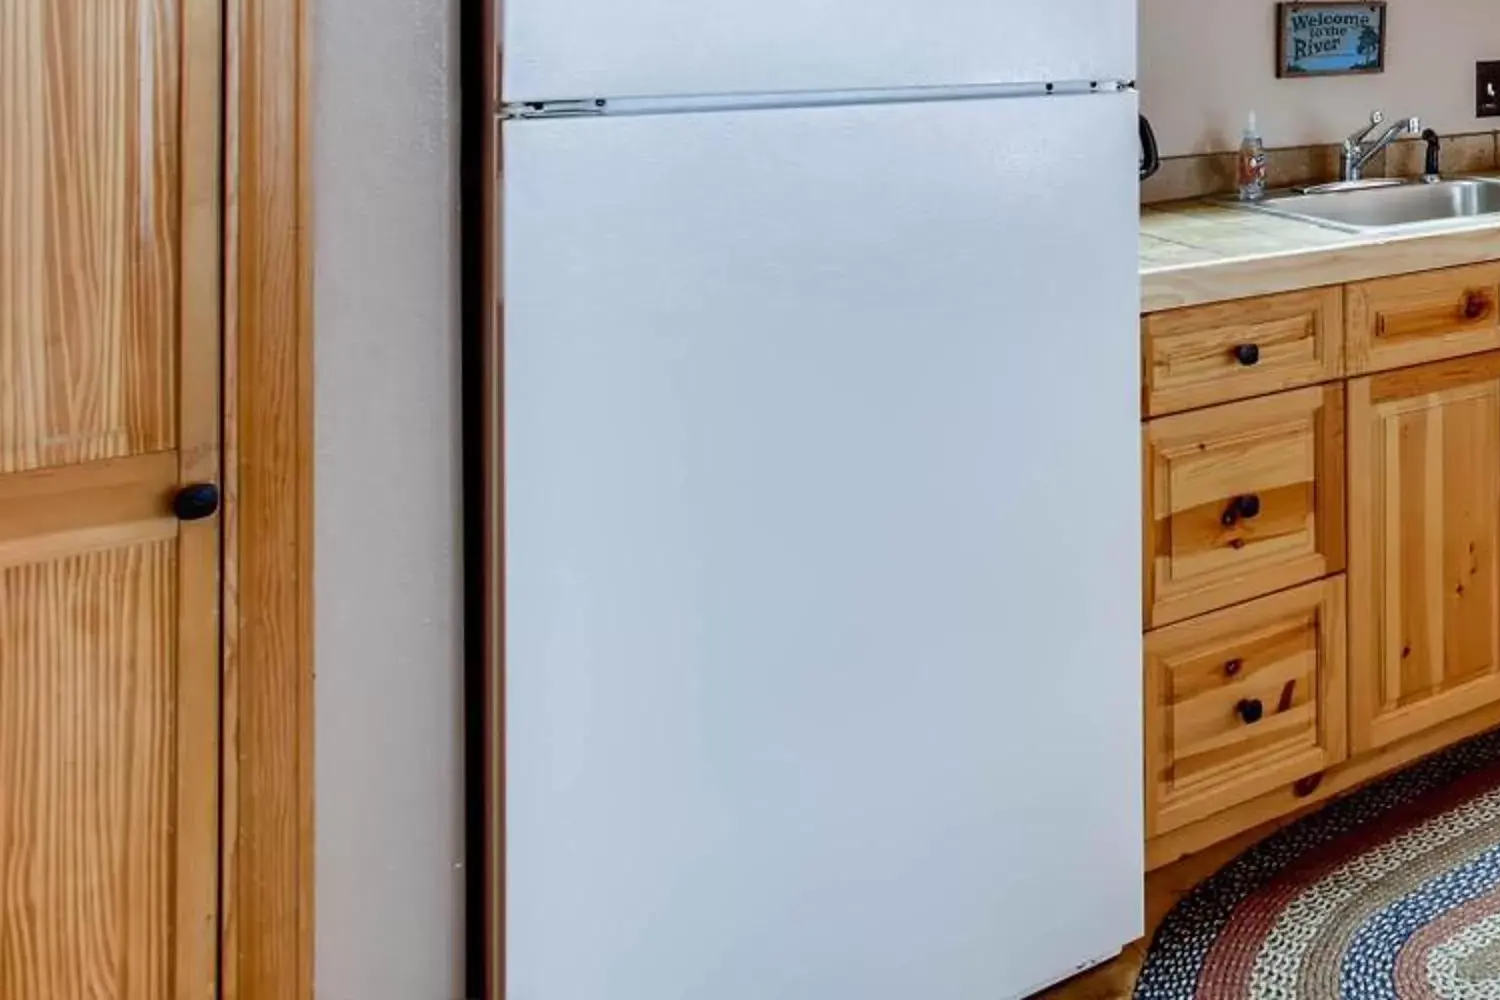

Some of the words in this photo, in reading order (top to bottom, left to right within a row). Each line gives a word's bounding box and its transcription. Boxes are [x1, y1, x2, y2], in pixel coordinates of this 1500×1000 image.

[1291, 13, 1370, 31] Welcome
[1309, 28, 1321, 39] to
[1322, 25, 1347, 38] the
[1294, 38, 1341, 60] River
